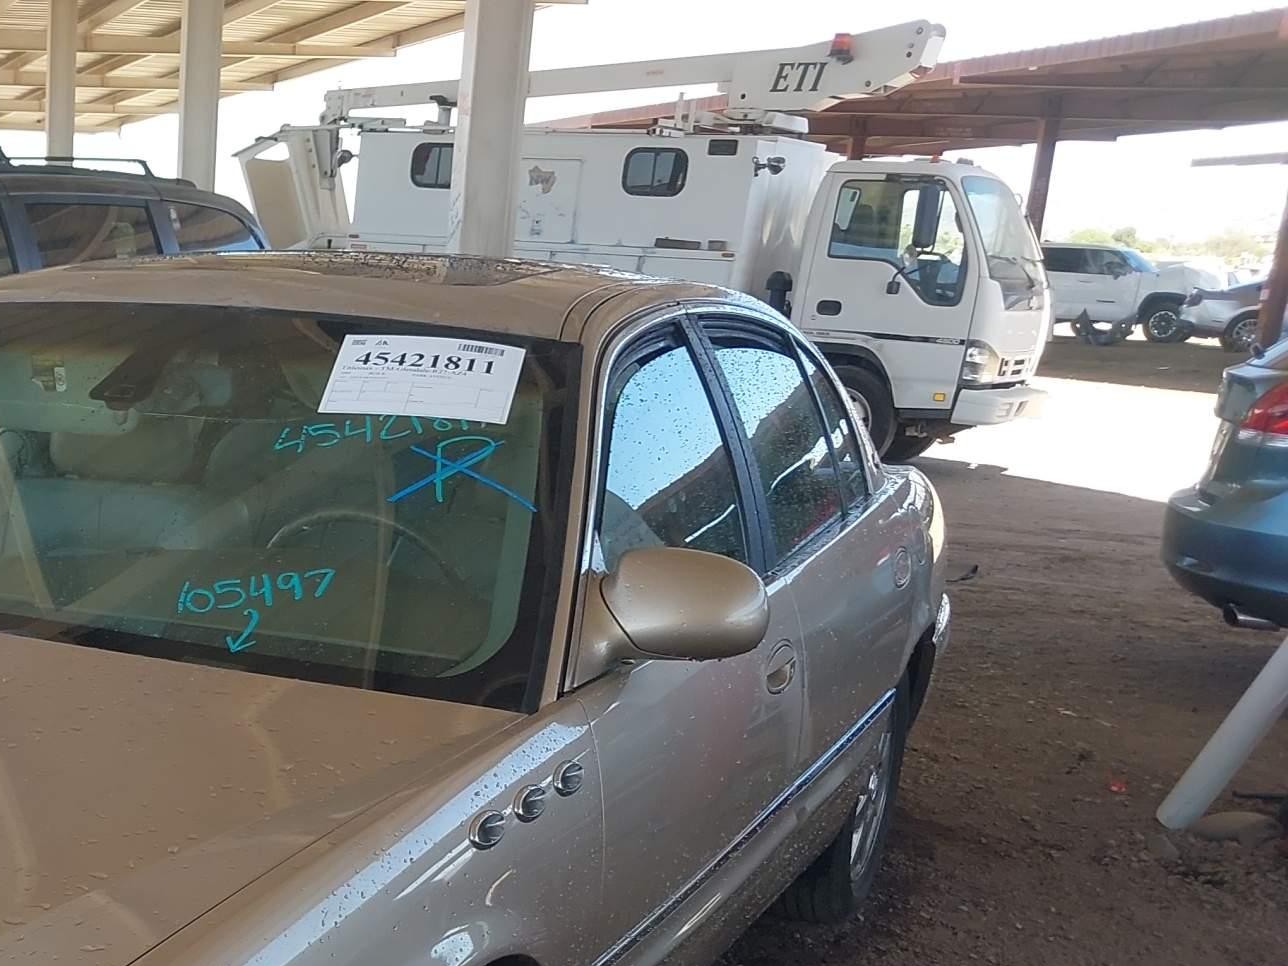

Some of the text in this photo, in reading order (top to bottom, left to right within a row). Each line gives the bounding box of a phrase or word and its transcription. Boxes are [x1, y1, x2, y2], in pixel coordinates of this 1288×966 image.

[768, 61, 829, 93] ETI
[354, 350, 495, 376] 45421811
[177, 568, 335, 613] 105497
